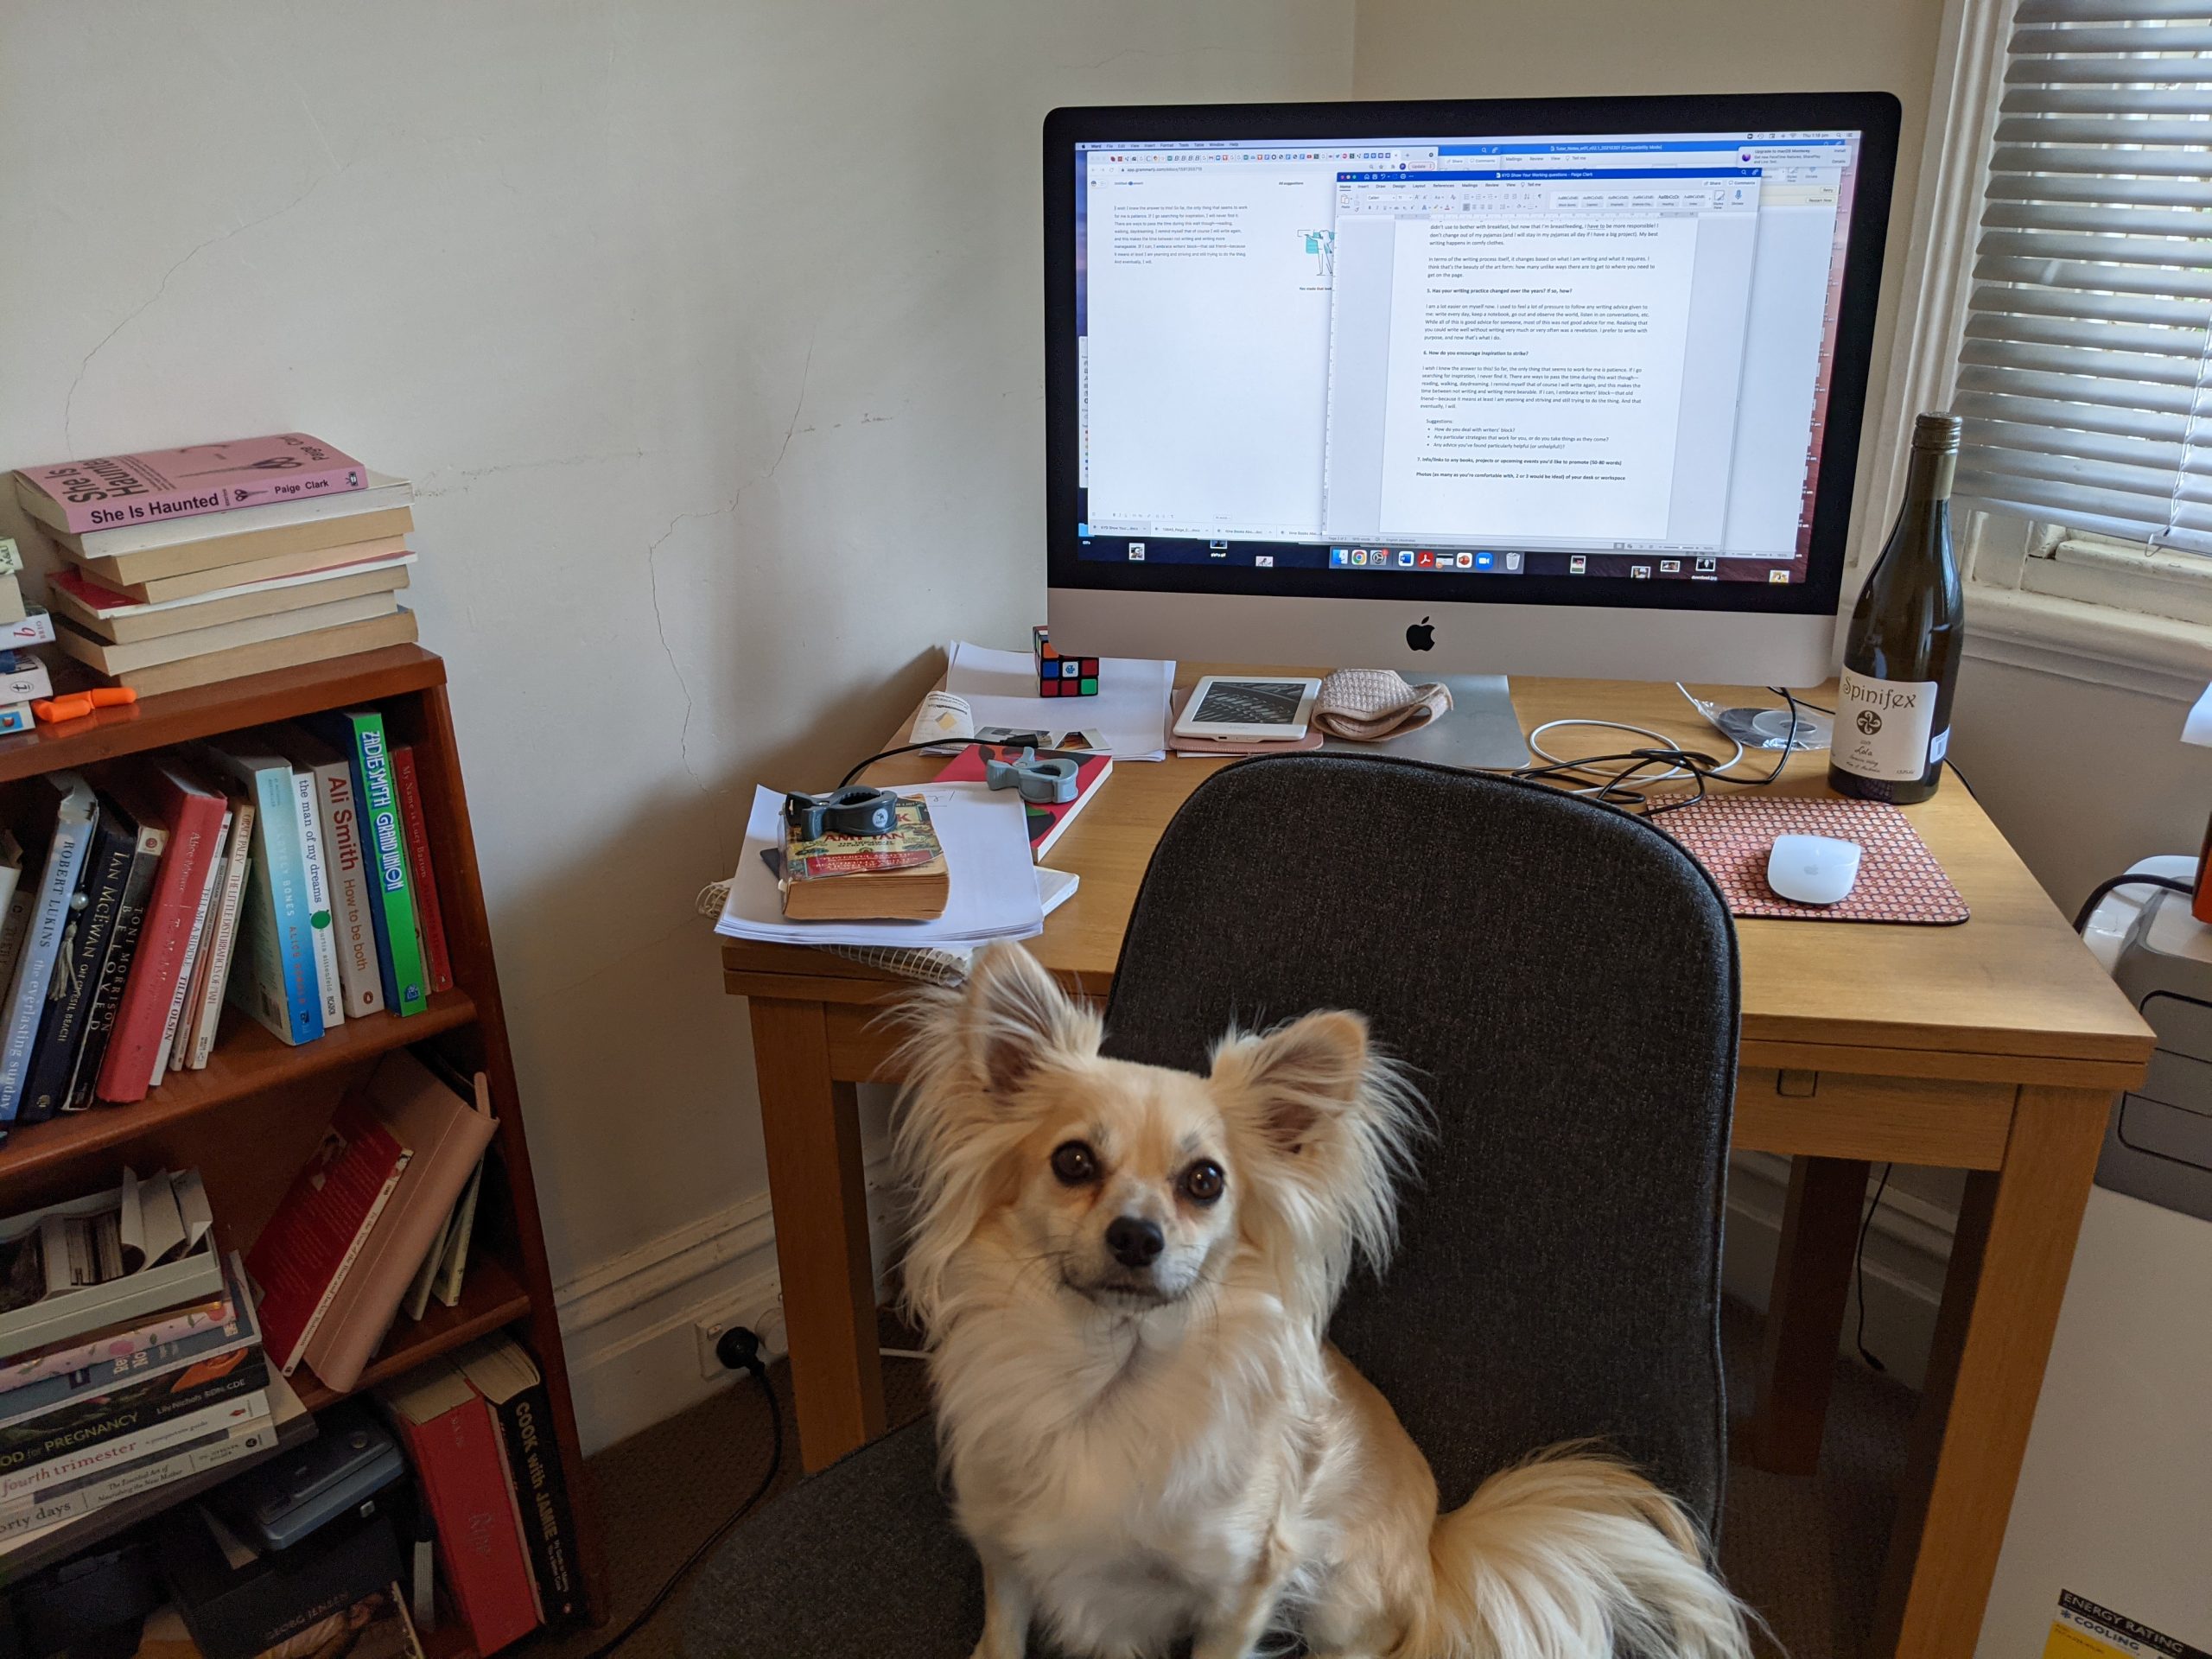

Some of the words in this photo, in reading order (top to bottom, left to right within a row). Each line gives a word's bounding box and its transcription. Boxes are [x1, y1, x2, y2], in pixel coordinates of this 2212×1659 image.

[63, 477, 108, 503] She
[275, 484, 301, 494] Paige
[305, 480, 329, 489] Clark
[90, 508, 124, 524] She
[129, 505, 145, 518] Is
[149, 493, 219, 515] Haunted
[1842, 676, 1916, 710] Spinifex
[361, 731, 384, 771] ZADIE
[299, 779, 309, 798] the
[368, 767, 391, 807] SMITH
[403, 766, 411, 781] My
[328, 776, 349, 804] Ali
[405, 781, 415, 810] Name
[240, 814, 252, 838] GRACE
[302, 802, 312, 828] man
[306, 830, 316, 843] of
[334, 809, 359, 871] Smith
[377, 811, 397, 856] GRAND
[411, 823, 422, 845] Lucy
[107, 851, 130, 880] IAN
[237, 838, 249, 864] PALEY
[306, 843, 316, 861] my
[53, 841, 75, 895] ROBERT
[232, 874, 240, 888] THE
[381, 851, 404, 893] UNION
[283, 880, 296, 917] BONES
[309, 864, 322, 904] dreams
[344, 878, 356, 907] How
[199, 887, 211, 912] TELL
[226, 888, 238, 918] LITTLE
[40, 899, 60, 947] LUKINS
[126, 906, 143, 944] TONI
[194, 910, 206, 925] ME
[347, 908, 359, 923] to
[290, 926, 301, 957] ALICE
[351, 923, 363, 942] be
[183, 933, 199, 965] RIDDLE
[353, 942, 369, 972] both
[78, 965, 89, 980] ON
[89, 906, 133, 1030] BELOVED
[323, 954, 333, 992] sittenfeld
[101, 952, 131, 1032] MORRISON
[173, 976, 188, 1005] TILLIE
[10, 982, 39, 1058] everlasting
[58, 1014, 73, 1042] BEACH
[166, 1006, 178, 1042] OLSEN
[0, 1061, 19, 1111] sunday
[226, 1378, 245, 1390] CDE
[28, 1445, 41, 1459] for
[44, 1410, 138, 1452] PREGNANCY
[516, 1402, 538, 1453] COOK
[0, 1471, 51, 1498] fourth
[53, 1440, 137, 1476] trimester
[527, 1453, 546, 1489] with
[107, 1481, 121, 1491] The
[35, 1503, 71, 1521] days
[536, 1491, 558, 1541] JAMIE
[2063, 1593, 2124, 1625] ENERGY
[2126, 1620, 2184, 1654] RATING
[2074, 1614, 2141, 1650] COOLING
